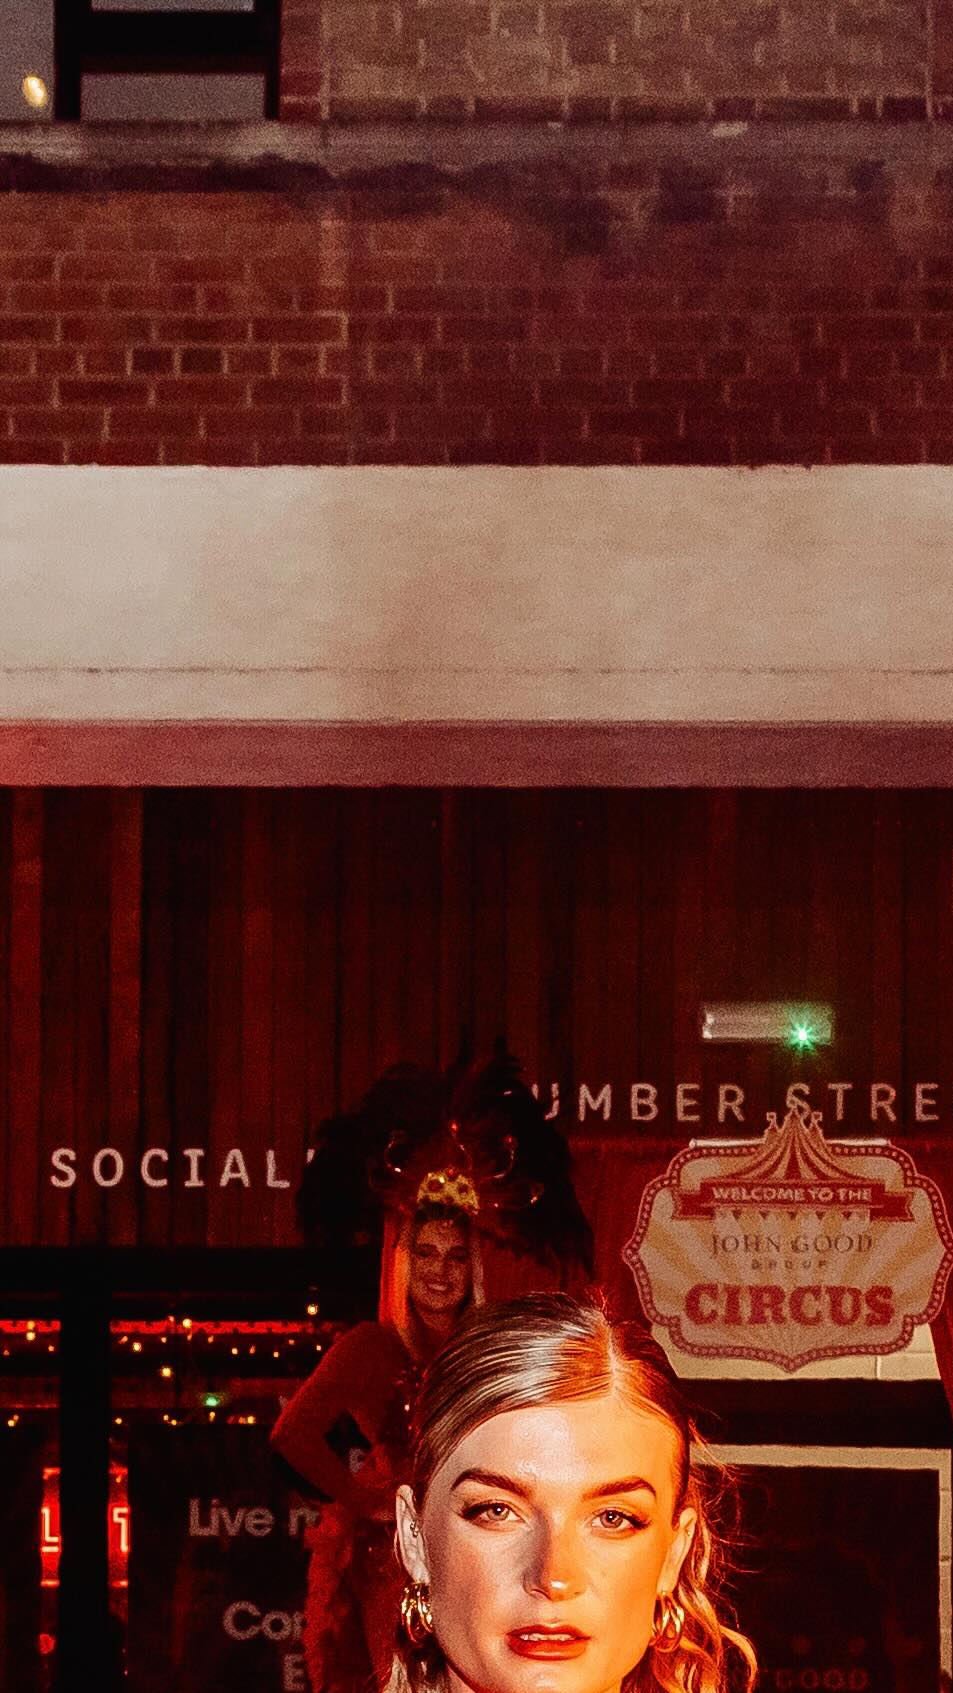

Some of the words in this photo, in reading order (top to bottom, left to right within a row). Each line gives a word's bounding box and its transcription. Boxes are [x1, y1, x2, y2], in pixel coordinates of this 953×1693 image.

[530, 1082, 746, 1122] UMBER
[49, 1147, 292, 1189] SOCIAL
[712, 1186, 806, 1201] WELCOME
[808, 1186, 834, 1201] TO
[837, 1187, 872, 1201] THE
[711, 1234, 781, 1257] JOHN
[790, 1234, 873, 1253] GOOD
[684, 1283, 897, 1328] CIRCUS
[188, 1498, 275, 1537] Live
